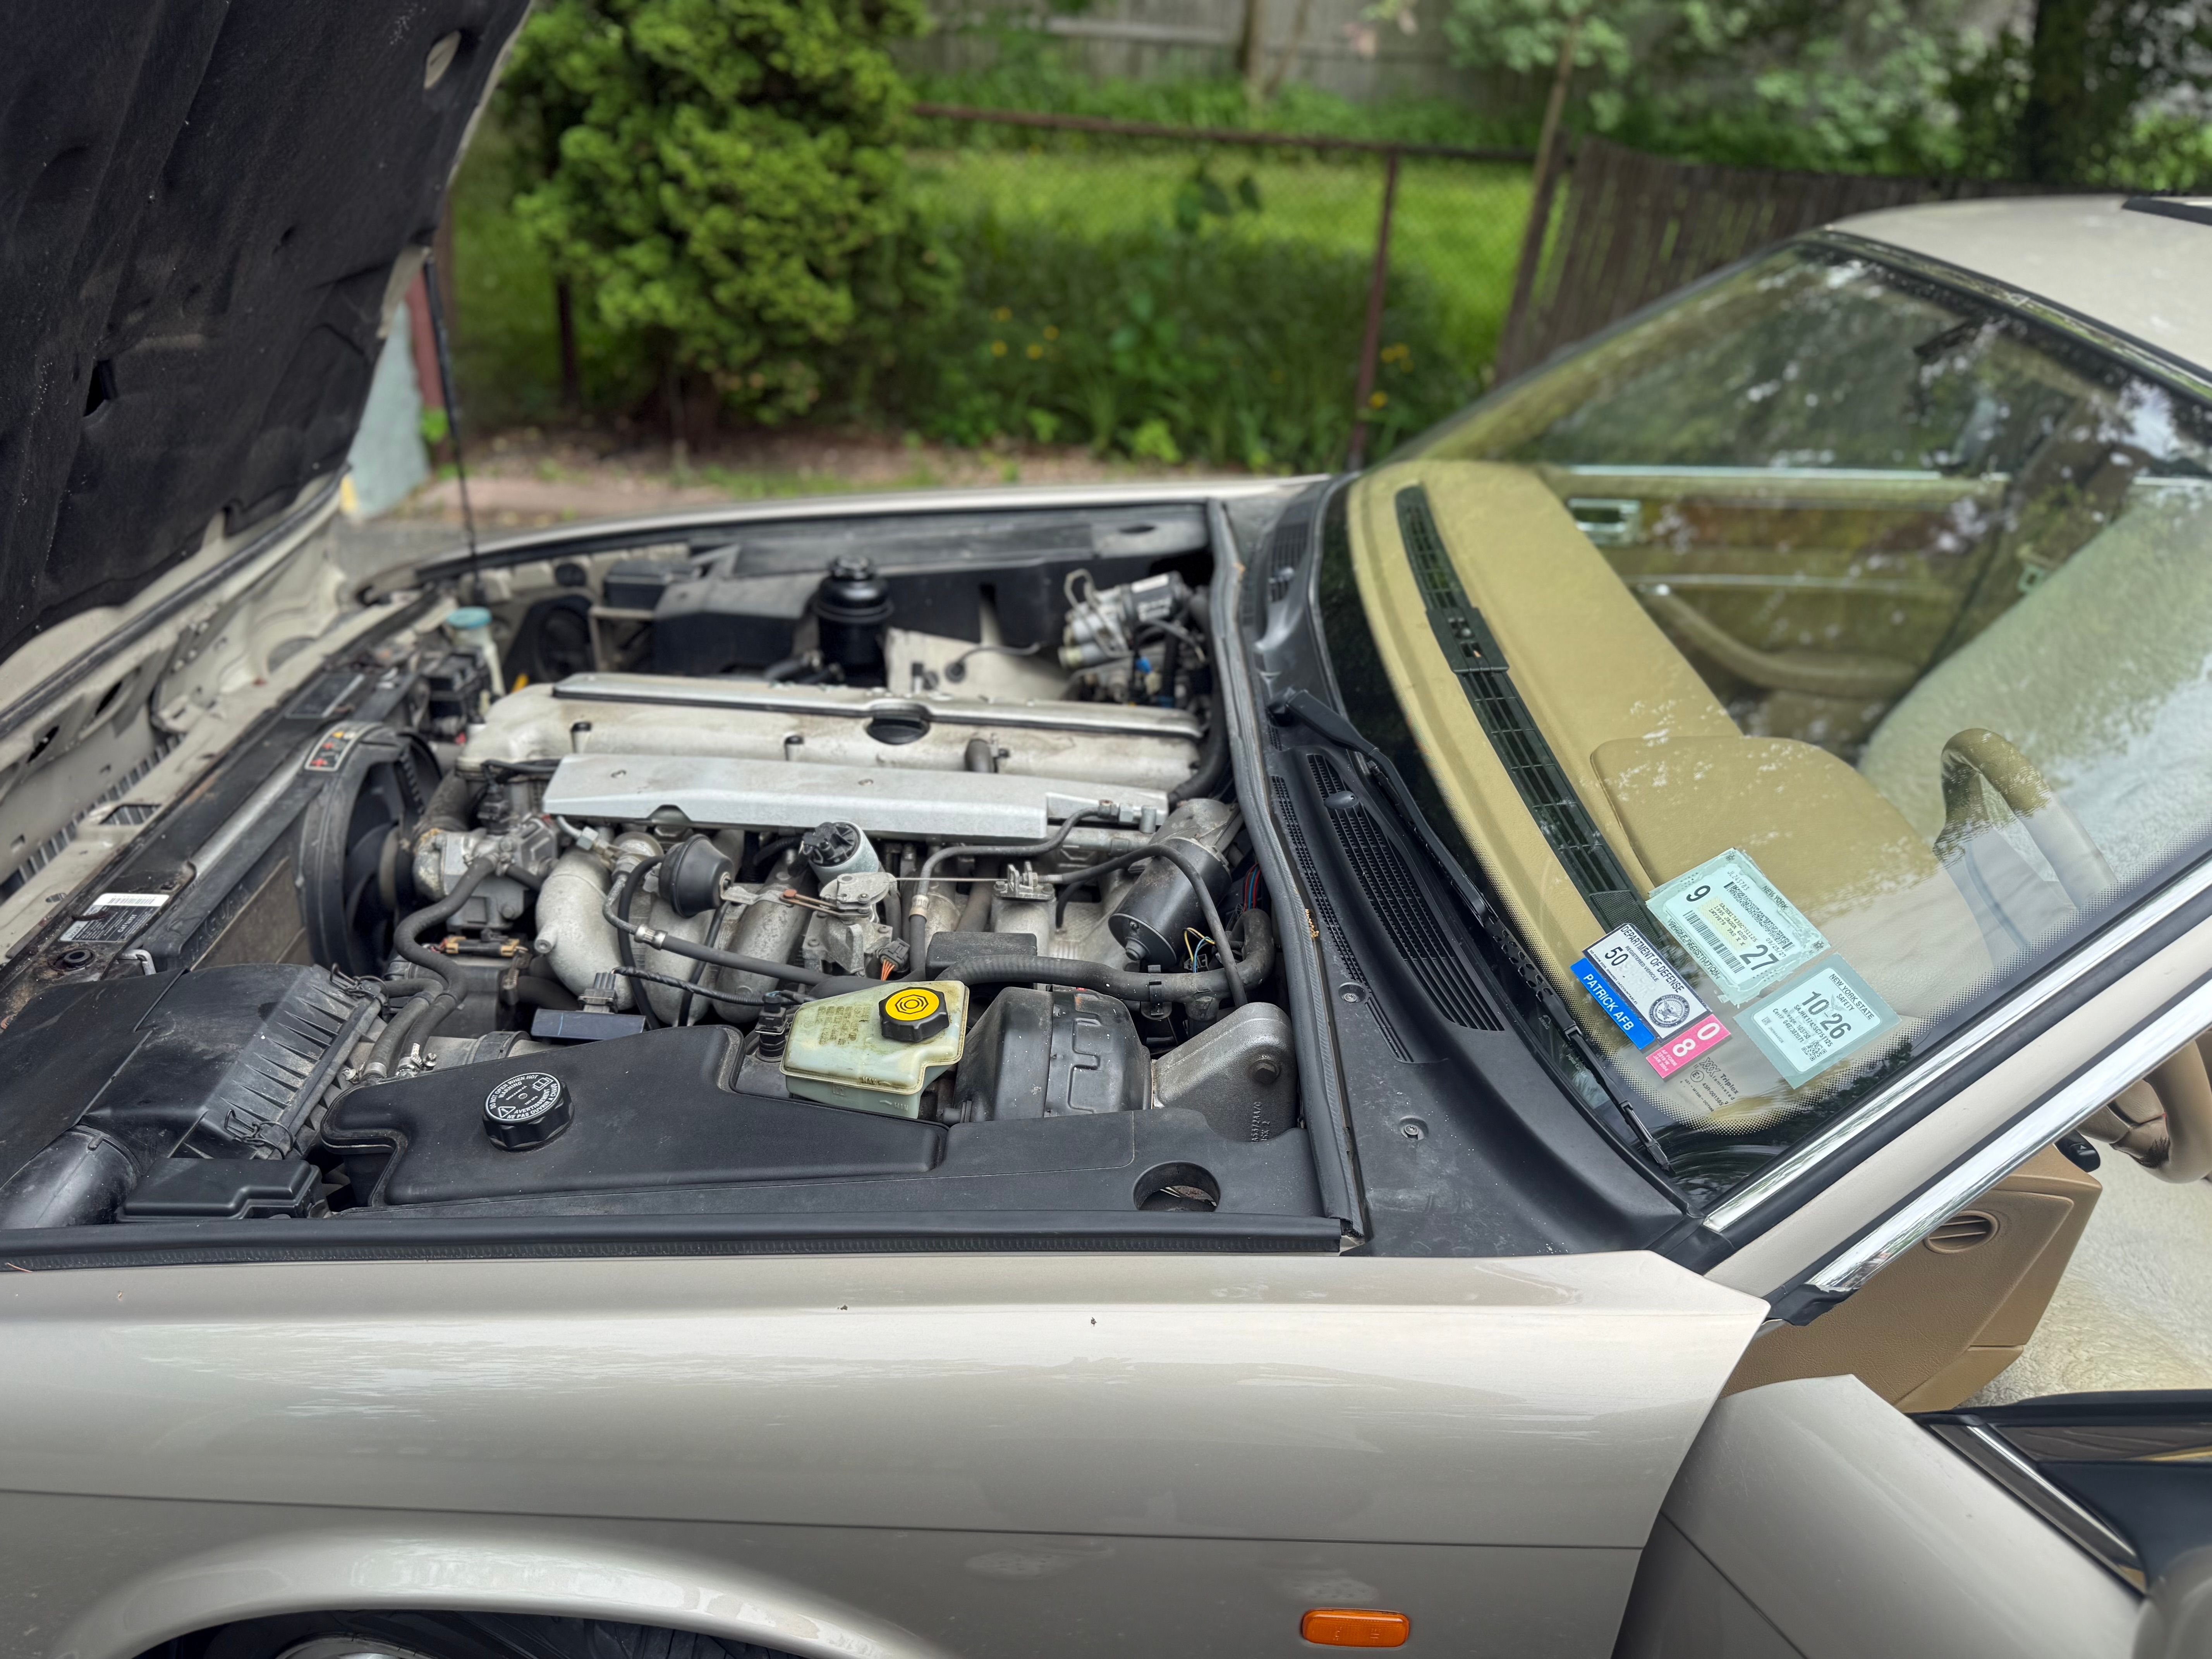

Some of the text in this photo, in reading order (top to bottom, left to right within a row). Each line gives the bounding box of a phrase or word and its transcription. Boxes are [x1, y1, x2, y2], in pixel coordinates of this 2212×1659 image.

[1686, 886, 1711, 902] 9
[1762, 886, 1788, 910] NEW YORK
[1714, 906, 1724, 915] 1995
[1605, 947, 1628, 966] 50
[1766, 938, 1786, 957] 09/25/27
[1621, 926, 1655, 959] DEPARTMENT
[1650, 958, 1662, 967] OF
[1657, 966, 1684, 993] DEFENSE
[1625, 946, 1659, 982] REGISTERED VEHICLE
[1740, 945, 1779, 970] 27
[1583, 974, 1634, 1030] PATRICK AFB
[1830, 974, 1874, 1020] NEW YORK STATE
[1837, 994, 1854, 1011] SAFETY
[1802, 991, 1851, 1039] 10-26
[1697, 1023, 1720, 1040] 0
[1673, 1039, 1695, 1056] 8
[1566, 1053, 1578, 1065] Jaguar
[1665, 1054, 1678, 1066] FORM
[489, 1095, 498, 1103] NOT
[496, 1084, 508, 1094] OPEN
[507, 1076, 525, 1085] WHEN
[498, 1081, 522, 1098] WARNING
[862, 1076, 877, 1085] MAX
[1712, 1076, 1735, 1100] laminated
[1721, 1074, 1738, 1094] Triplex
[514, 1089, 550, 1114] AVERTISSEMENT
[531, 1101, 551, 1114] OUVRIR
[894, 1102, 908, 1111] MIN
